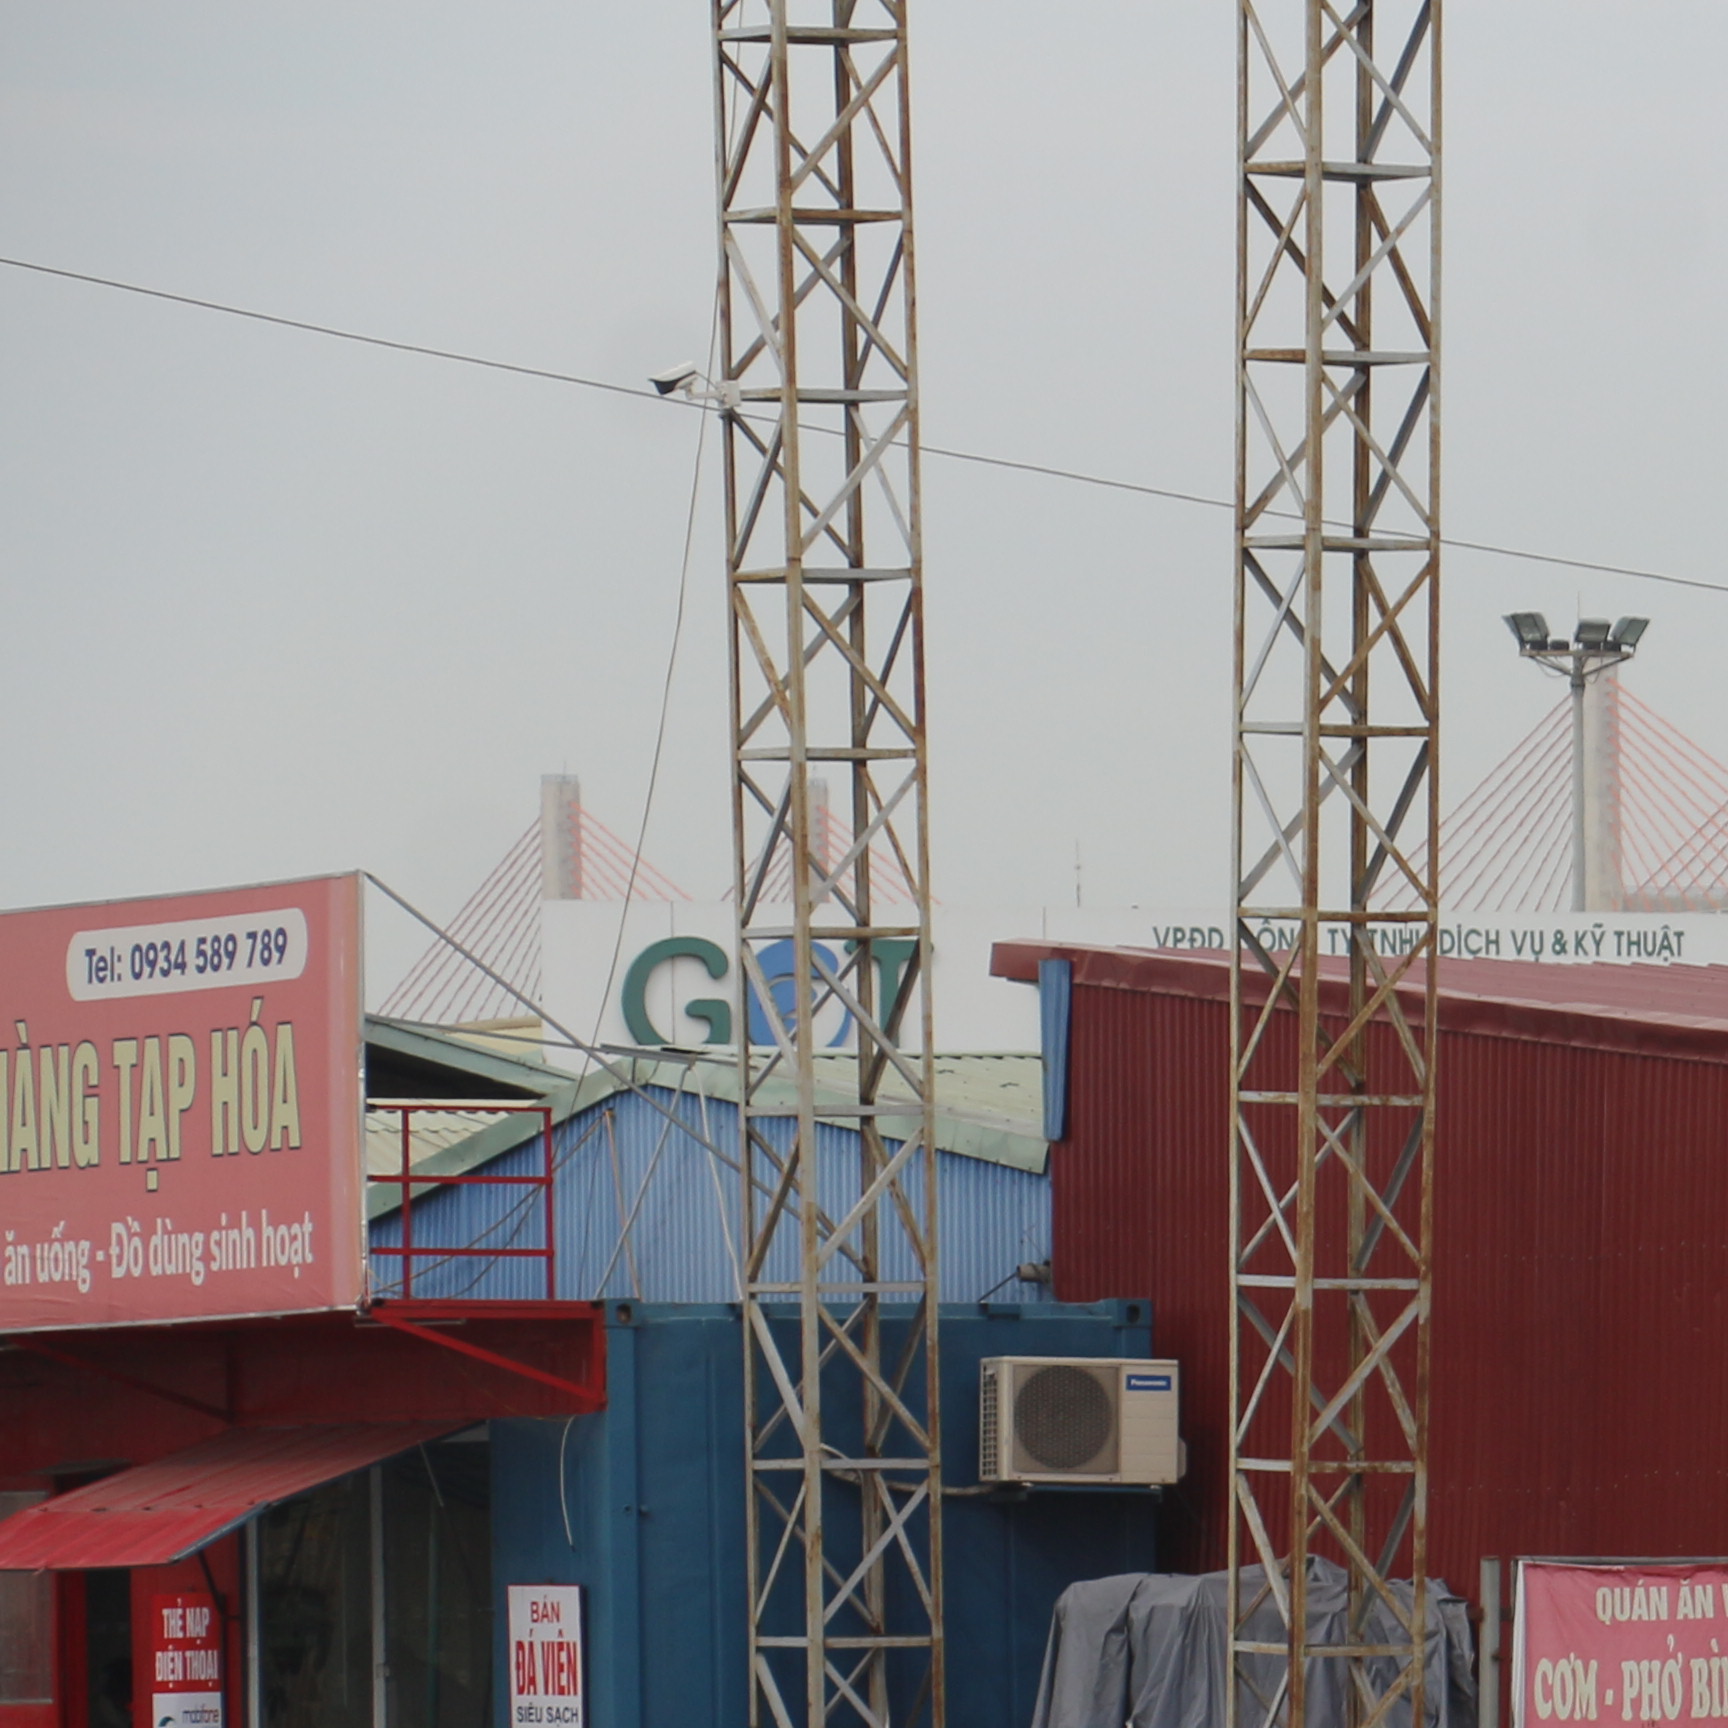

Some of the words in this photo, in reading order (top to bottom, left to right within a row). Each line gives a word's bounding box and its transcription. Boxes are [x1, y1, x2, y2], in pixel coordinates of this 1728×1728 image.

[84, 946, 122, 985] Tel:
[130, 939, 187, 980] 0934
[195, 933, 237, 974] 589
[245, 927, 287, 969] 789
[1152, 927, 1224, 948] VPĐD
[1511, 930, 1544, 962] VỤ
[1551, 929, 1567, 955] &
[1574, 923, 1606, 956] KỸ
[1614, 924, 1685, 962] THUẬT
[0, 1019, 100, 1175] ÀNG
[112, 1032, 196, 1192] TẠP
[210, 996, 301, 1157] HÓA
[4, 1229, 30, 1285] ăn
[36, 1220, 91, 1293] uống
[109, 1216, 143, 1278] Đồ
[149, 1217, 204, 1286] dùng
[210, 1210, 255, 1271] sinh
[261, 1208, 314, 1279] hoạt
[162, 1598, 184, 1639] THẺ
[185, 1607, 210, 1645] NẠP
[531, 1595, 560, 1623] BÁN
[1596, 1579, 1668, 1625] QUÁN
[1677, 1579, 1714, 1620] ĂN
[155, 1644, 183, 1688] ĐIỆN
[185, 1650, 218, 1687] THOẠI
[516, 1628, 537, 1695] ĐÁ
[541, 1629, 577, 1696] VIÊN
[1534, 1652, 1598, 1721] CƠM
[1621, 1634, 1683, 1721] PHỞ
[517, 1702, 542, 1723] SIÊU
[547, 1706, 578, 1728] SẠCH
